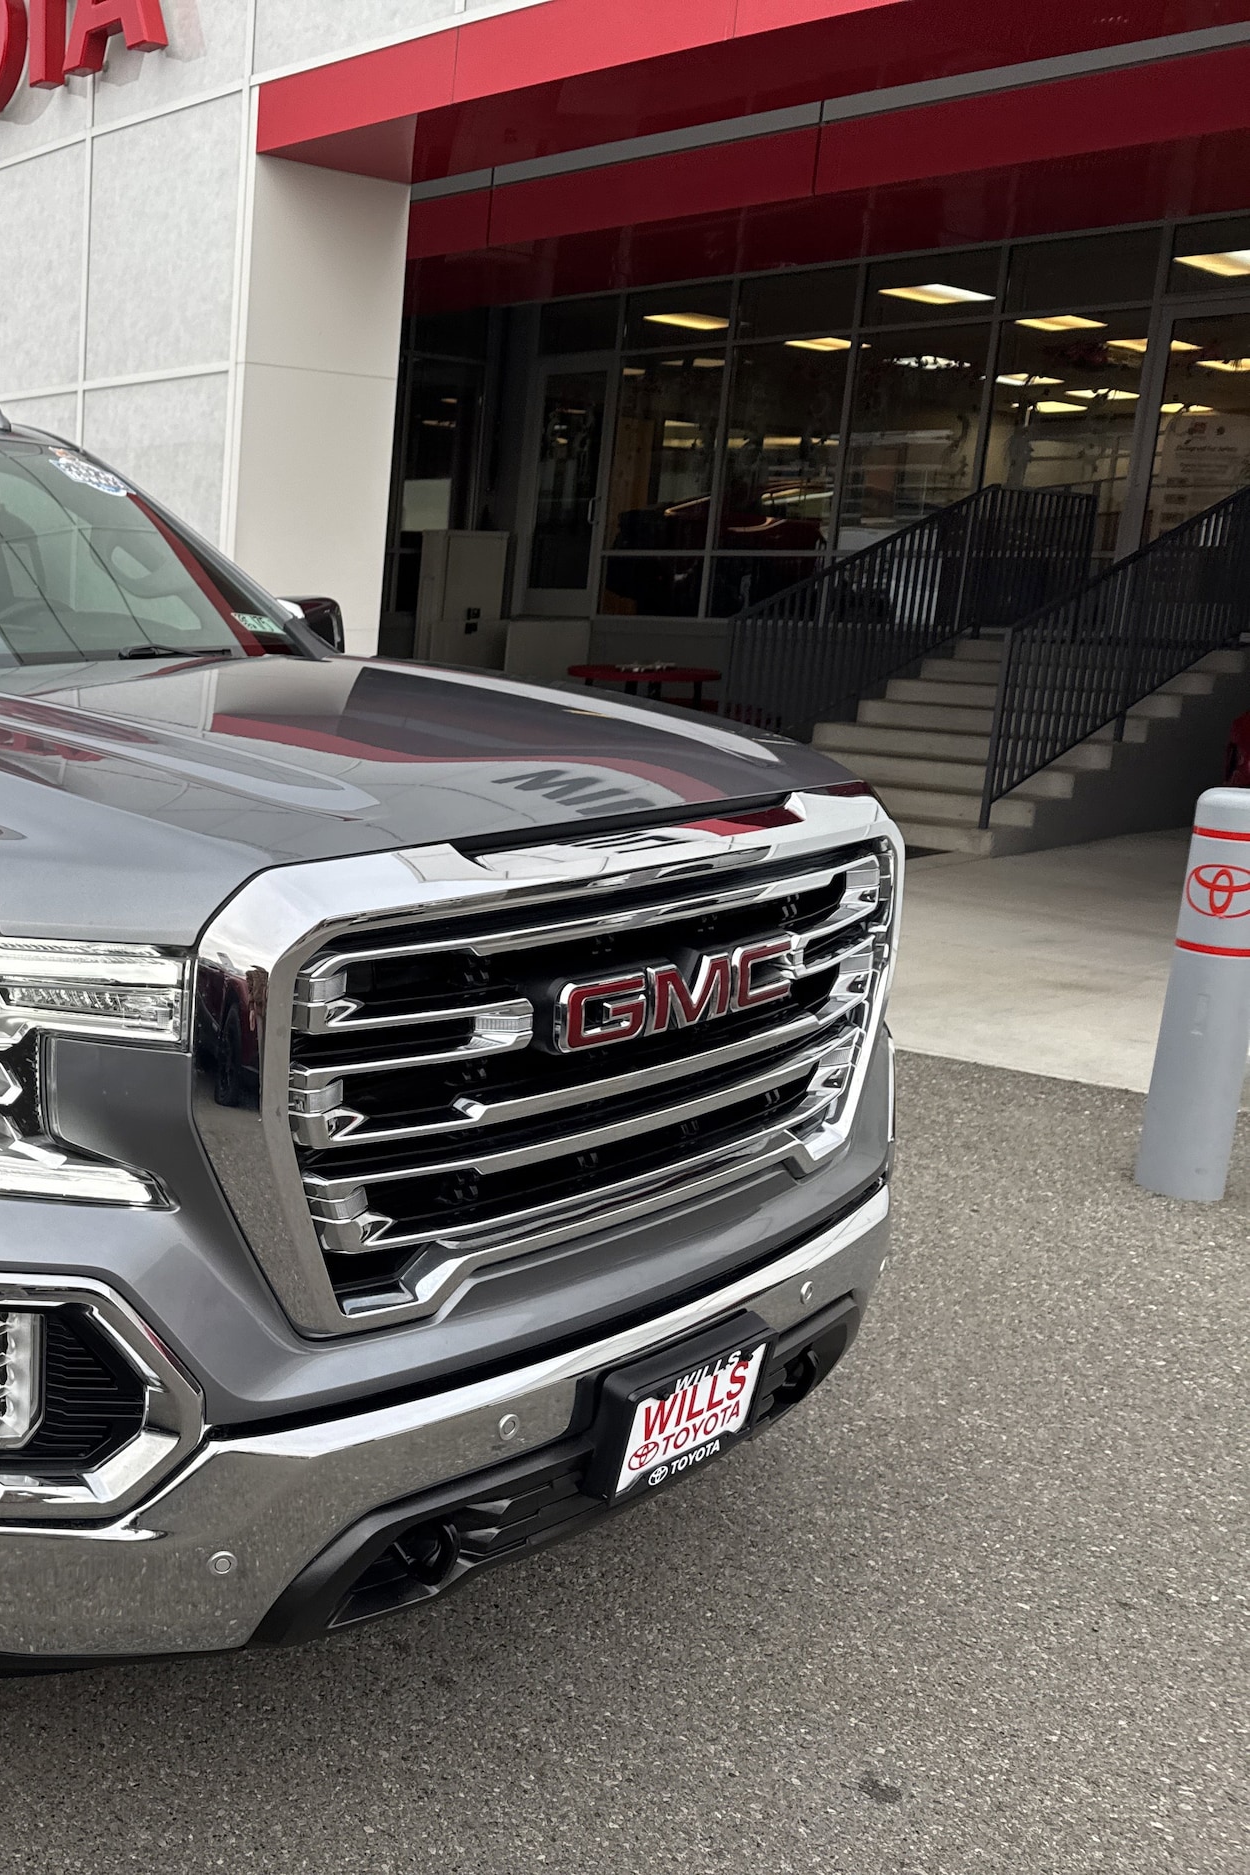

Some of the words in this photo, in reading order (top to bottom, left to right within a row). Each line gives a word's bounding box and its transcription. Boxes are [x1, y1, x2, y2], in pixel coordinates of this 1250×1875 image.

[553, 934, 792, 1054] GMC
[643, 1361, 750, 1441] WILLS
[662, 1400, 742, 1456] TOYOTA
[670, 1439, 721, 1475] TOYOTA
